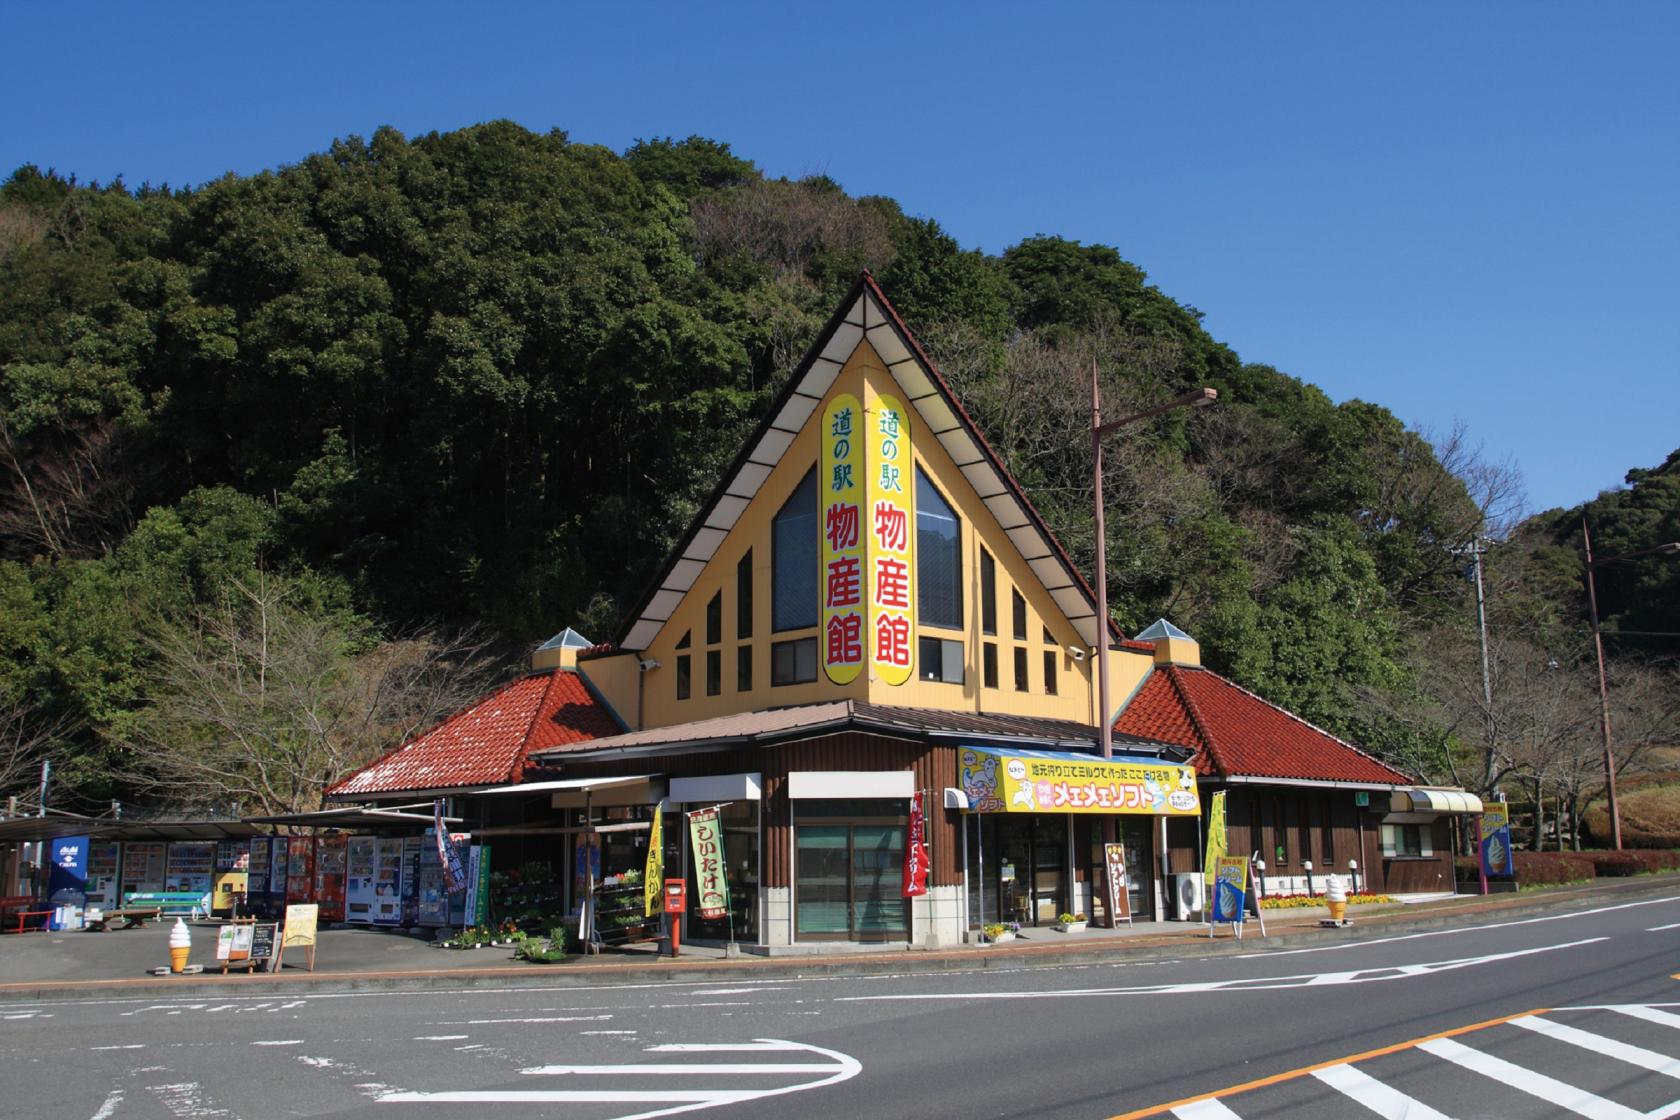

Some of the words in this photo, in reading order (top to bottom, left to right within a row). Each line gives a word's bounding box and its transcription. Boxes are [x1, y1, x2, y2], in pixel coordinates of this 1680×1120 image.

[831, 408, 854, 491] 道の駅
[879, 409, 902, 492] 道の駅
[826, 501, 862, 666] 物産館
[875, 501, 910, 667] 物産館
[1054, 781, 1153, 808] メェメェソフト
[649, 849, 660, 911] きんかん
[697, 826, 719, 889] しいたけ
